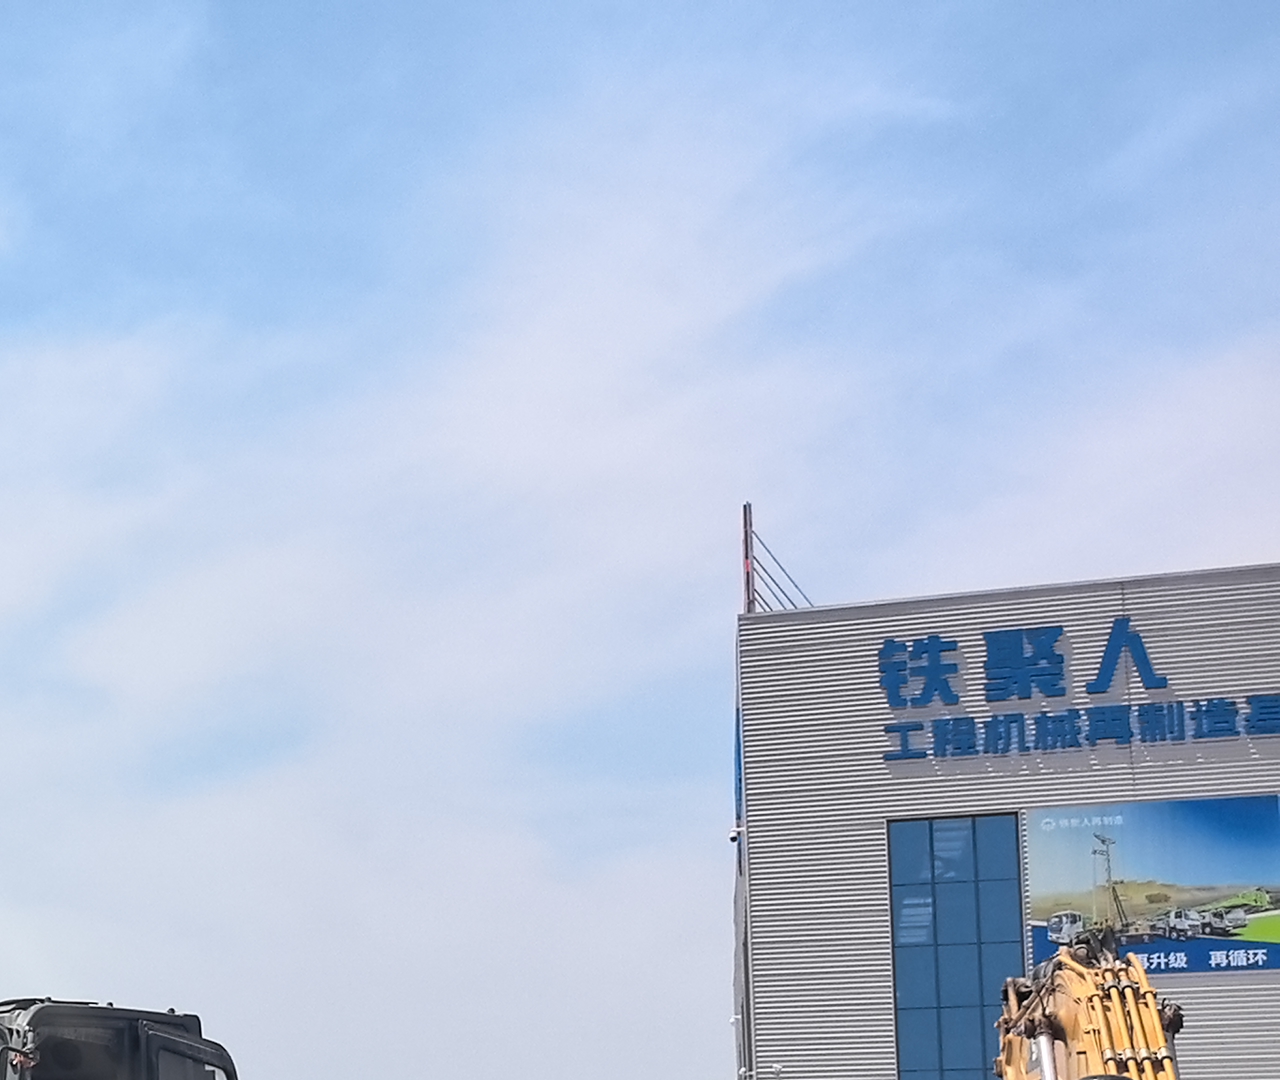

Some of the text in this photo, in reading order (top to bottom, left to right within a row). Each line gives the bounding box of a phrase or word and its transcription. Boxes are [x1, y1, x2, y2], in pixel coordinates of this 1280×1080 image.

[878, 617, 1168, 708] 铁聚人
[1208, 949, 1268, 968] 再循环
